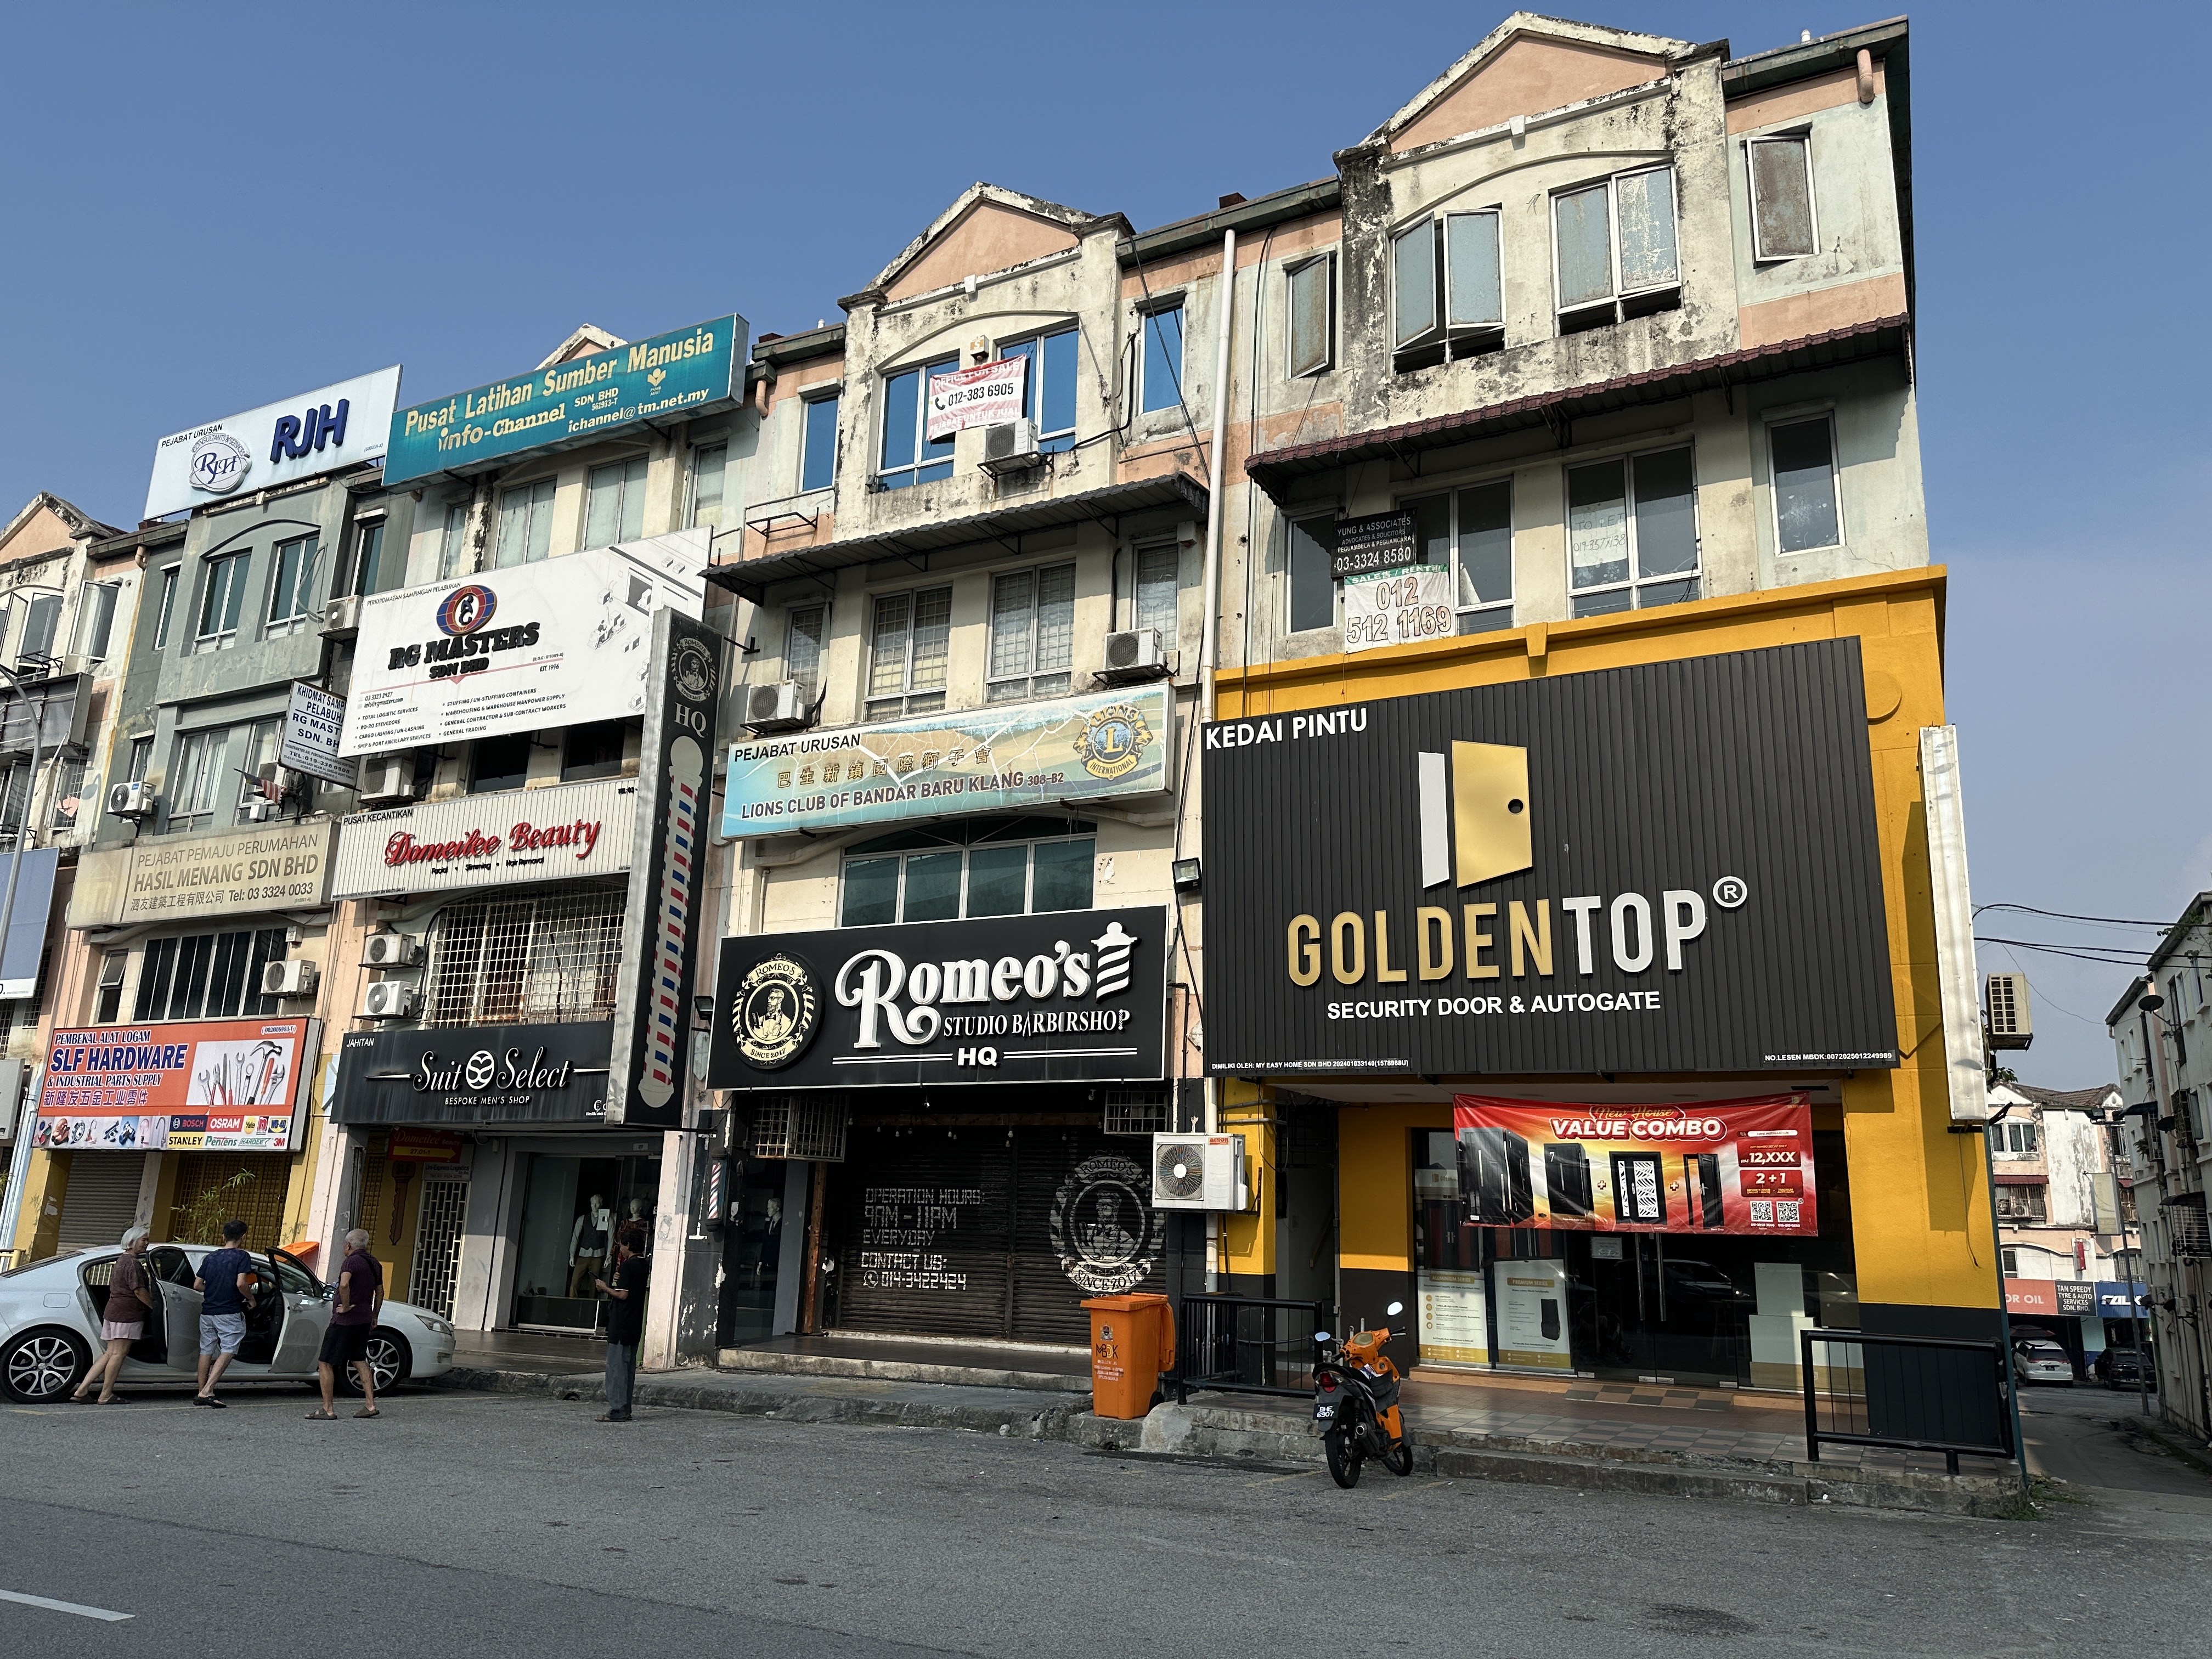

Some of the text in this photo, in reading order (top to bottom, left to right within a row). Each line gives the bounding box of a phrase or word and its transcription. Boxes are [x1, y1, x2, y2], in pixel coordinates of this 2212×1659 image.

[405, 328, 714, 437] Pusat Latihan Sumber Manusia
[574, 393, 595, 408] SDN
[597, 387, 619, 401] BHD
[591, 398, 618, 411] 561933-T
[948, 382, 1013, 407] 012-383 6905
[161, 423, 223, 449] PEJABAT URUSAN
[270, 398, 349, 464] RJH
[1337, 516, 1411, 537] YUNG ASSOCIATES
[1341, 528, 1406, 546] ADVOCATES SOLICITORS
[1338, 541, 1370, 554] PEGUAMBELA
[1336, 546, 1412, 571] 03-3324 8580
[403, 588, 432, 599] SAMPINGAN
[432, 582, 461, 592] PELABUHAN
[1376, 576, 1419, 611] 012
[1346, 606, 1452, 644] 512 1169
[387, 621, 541, 671] RG MASTERS
[430, 657, 489, 679] SDN BHD
[297, 684, 326, 704] KHIDMAT
[445, 693, 566, 716] WAREHOUSING WAREHOUSE MANPOWER SUPPLY
[473, 688, 537, 703] UN-STUFFING CONTAINERS
[292, 712, 307, 725] RG
[375, 719, 401, 728] STEVEDORE
[444, 703, 566, 726] GENERAL CONTRACTOR SUB-CONTRACT WORKERS
[674, 702, 707, 738] HQ
[297, 728, 323, 744] SDN.
[1205, 708, 1368, 752] KEDAI PINTU
[734, 733, 861, 763] PEJABAT URUSAN
[777, 745, 993, 788] 巴生新鎮國際獅子會
[1085, 755, 1138, 780] INTERNATIONAL
[741, 771, 1065, 820] LIONS CLUB OF BANDAR BARU KLANG 308-B2
[343, 809, 414, 826] PUSAT KECANTIKAN
[509, 818, 601, 859] Beauty
[137, 833, 318, 868] PEJABAT PEMAJU PERUMAHAN
[134, 854, 319, 893] HASIL MENANG SDN BHD
[130, 889, 225, 912] 泗友建築工程有限公司
[228, 881, 313, 903] Tel: 03 3324 0033
[754, 962, 797, 980] ROMEO'S
[835, 940, 1091, 1048] Romeo's
[1327, 991, 1661, 1020] SECURITY DOOR & AUTOGATE
[943, 1013, 1007, 1038] STUDIO
[54, 1030, 151, 1045] PEMBEKAL ALAT LOGAM
[346, 1037, 375, 1048] JAHITAN
[50, 1042, 189, 1072] SLF HARDWARE
[957, 1047, 997, 1068] HQ
[413, 1046, 571, 1092] Suit Select
[55, 1072, 163, 1088] INDUSTRIAL PARTS SUPPLY
[445, 1095, 530, 1105] BESPOKE MEN'S SHOP
[182, 1118, 206, 1128] BOSCH
[210, 1118, 241, 1130] OSRAM
[1551, 1118, 1722, 1138] VALUE COMBO
[168, 1136, 203, 1146] STANLEY
[205, 1136, 238, 1147] Pentens
[273, 1137, 285, 1147] 3M
[1079, 1159, 1137, 1175] ROMEO'S
[1749, 1151, 1796, 1165] 12,XXX
[865, 1188, 985, 1205] OPERATION HOURS:
[865, 1205, 899, 1228] 9AM
[862, 1229, 935, 1246] EVERYDAY
[861, 1251, 921, 1270] CONTACT
[881, 1271, 967, 1290] 014-3422424
[2069, 1285, 2092, 1294] SPEEDY
[2023, 1295, 2044, 1305] OIL
